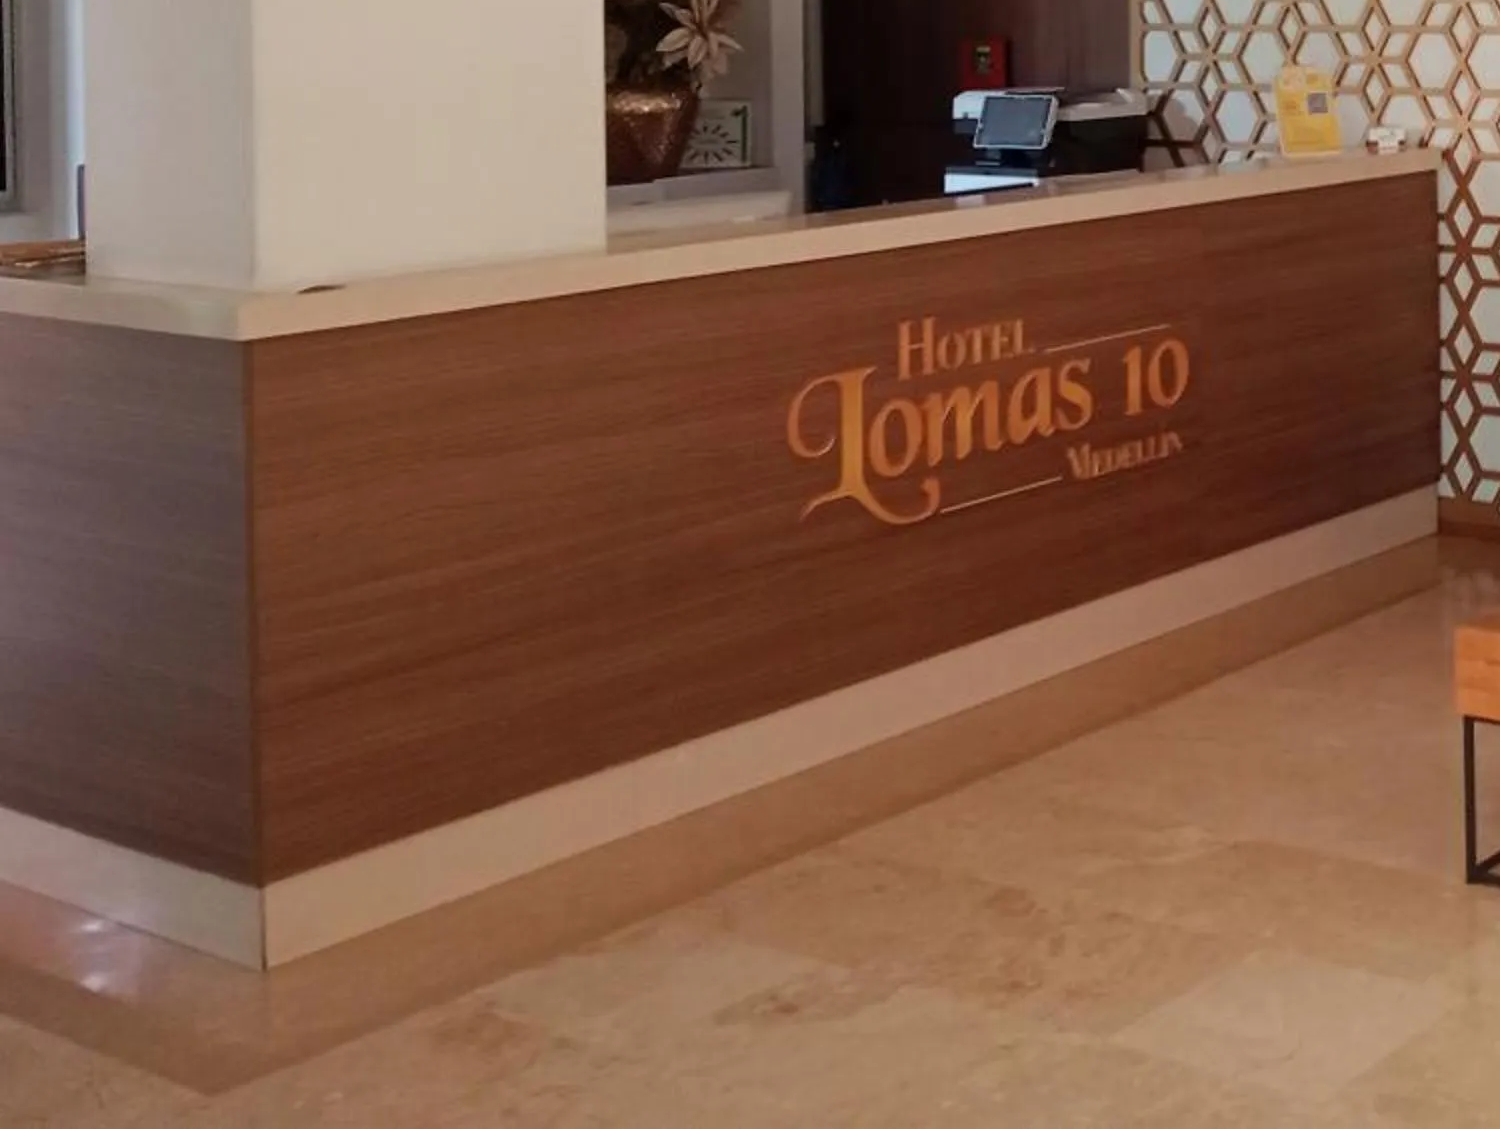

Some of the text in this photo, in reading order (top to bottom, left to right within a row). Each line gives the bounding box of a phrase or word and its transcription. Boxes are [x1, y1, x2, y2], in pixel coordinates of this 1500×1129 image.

[899, 317, 1029, 381] HOTEL
[787, 338, 1190, 525] Lomas 10
